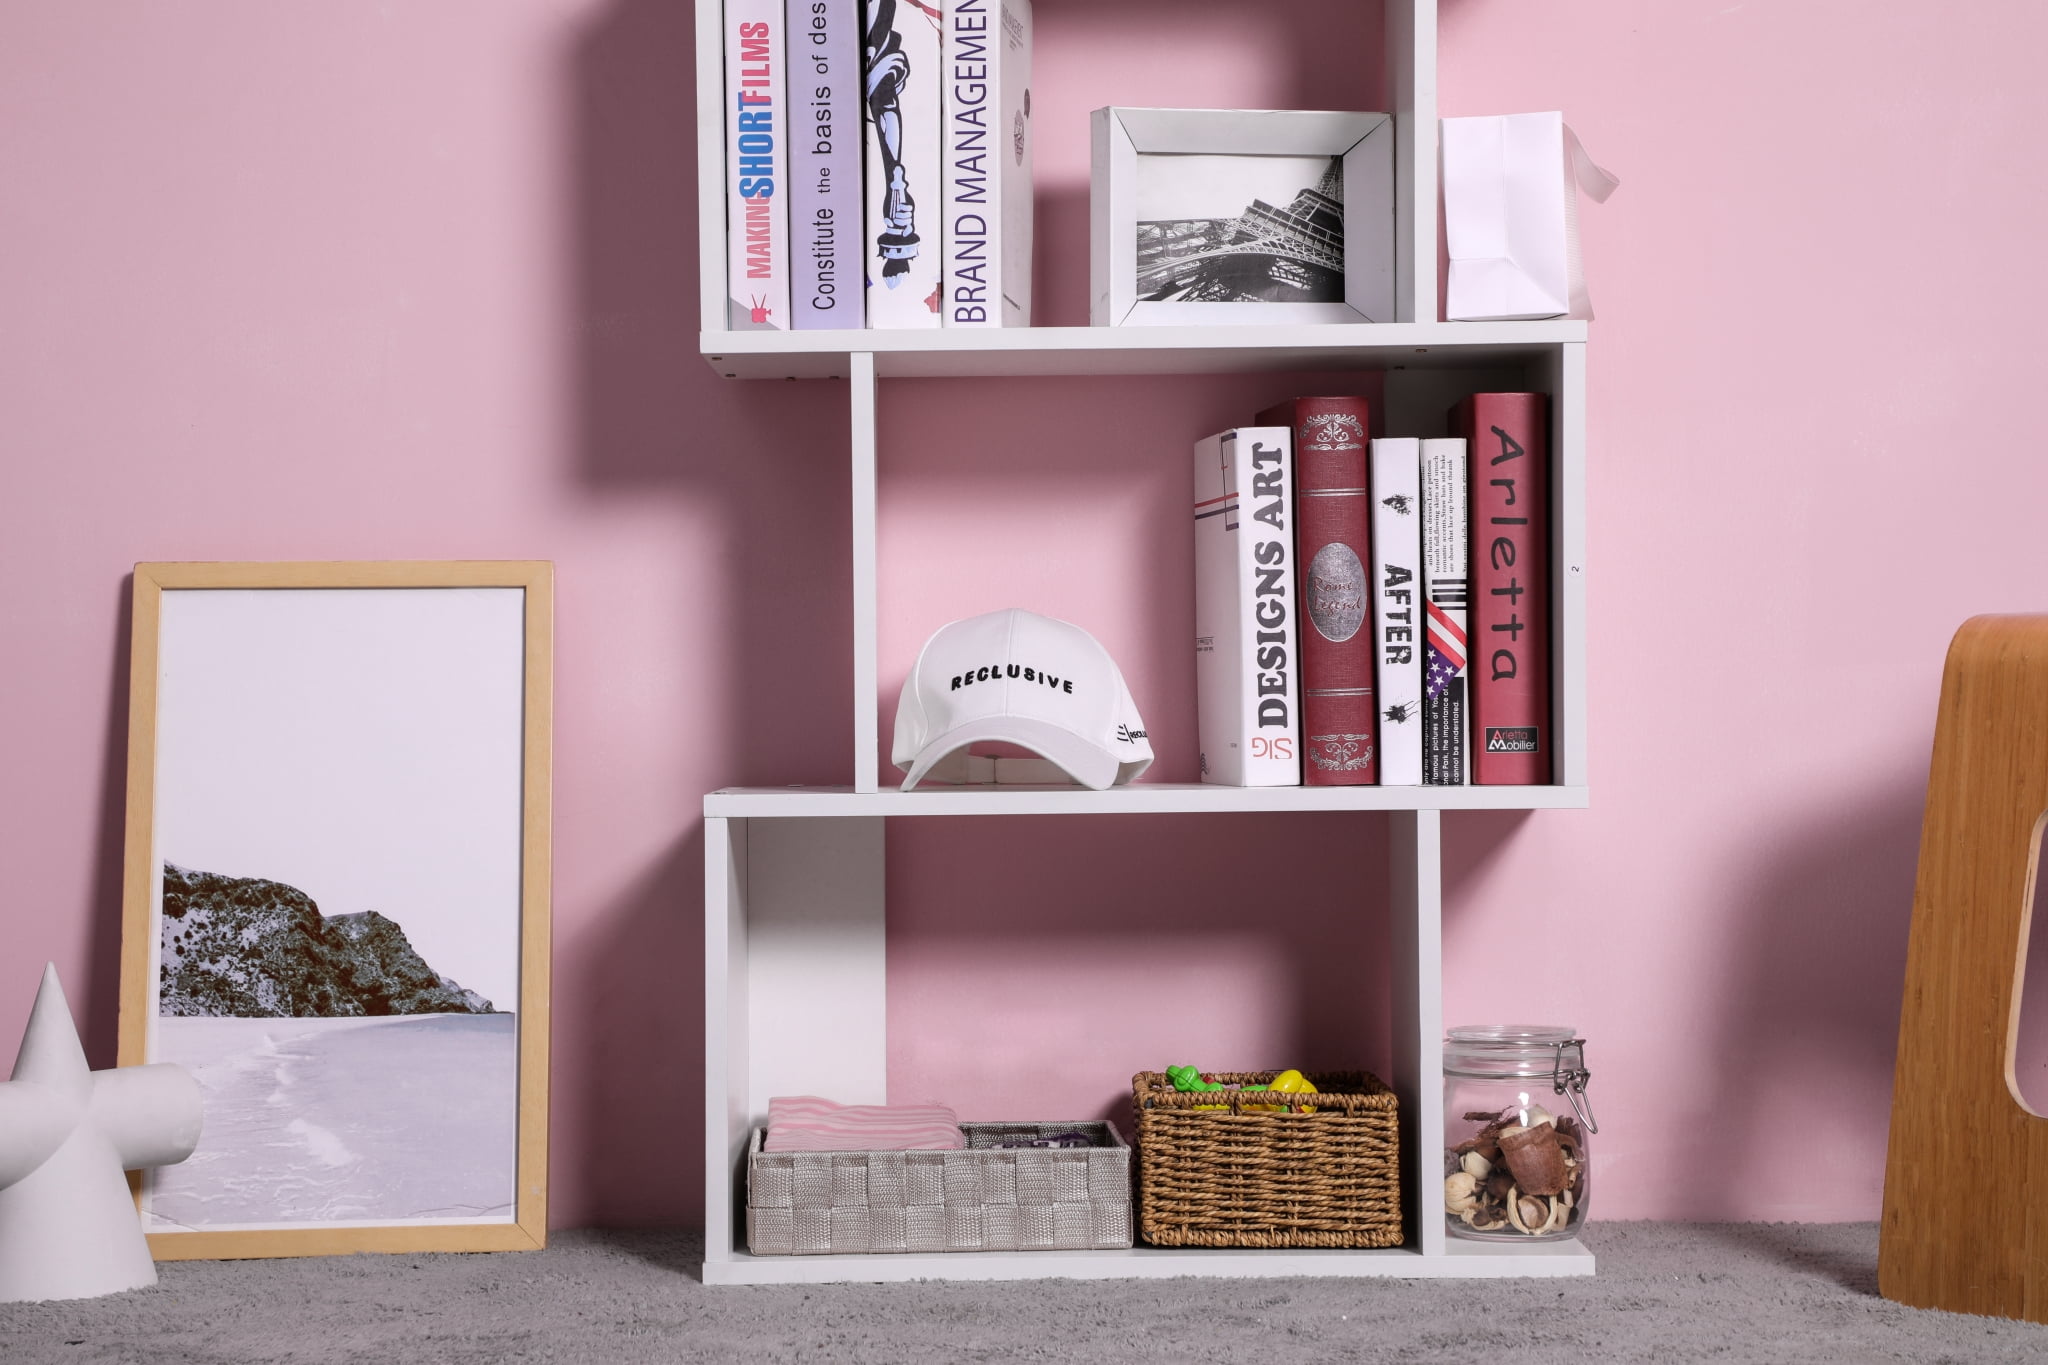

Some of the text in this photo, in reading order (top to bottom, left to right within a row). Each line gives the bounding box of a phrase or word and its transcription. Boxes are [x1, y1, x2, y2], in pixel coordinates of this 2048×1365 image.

[812, 55, 829, 74] of
[811, 85, 832, 155] basis
[738, 22, 774, 279] MAKING SHORT FILMS
[817, 167, 831, 194] the
[812, 208, 836, 310] Constitute
[955, 214, 986, 322] BRAND
[1490, 425, 1528, 681] Arletta
[1251, 442, 1288, 728] DESIGNS ART
[1314, 596, 1361, 617] Legend
[1385, 564, 1412, 664] AFTER
[951, 664, 1073, 694] RECLUSIVE
[1443, 688, 1449, 696] of
[1433, 711, 1438, 720] of
[1488, 740, 1536, 750] Mobilier
[1493, 730, 1528, 740] Arletta
[1453, 745, 1459, 756] be
